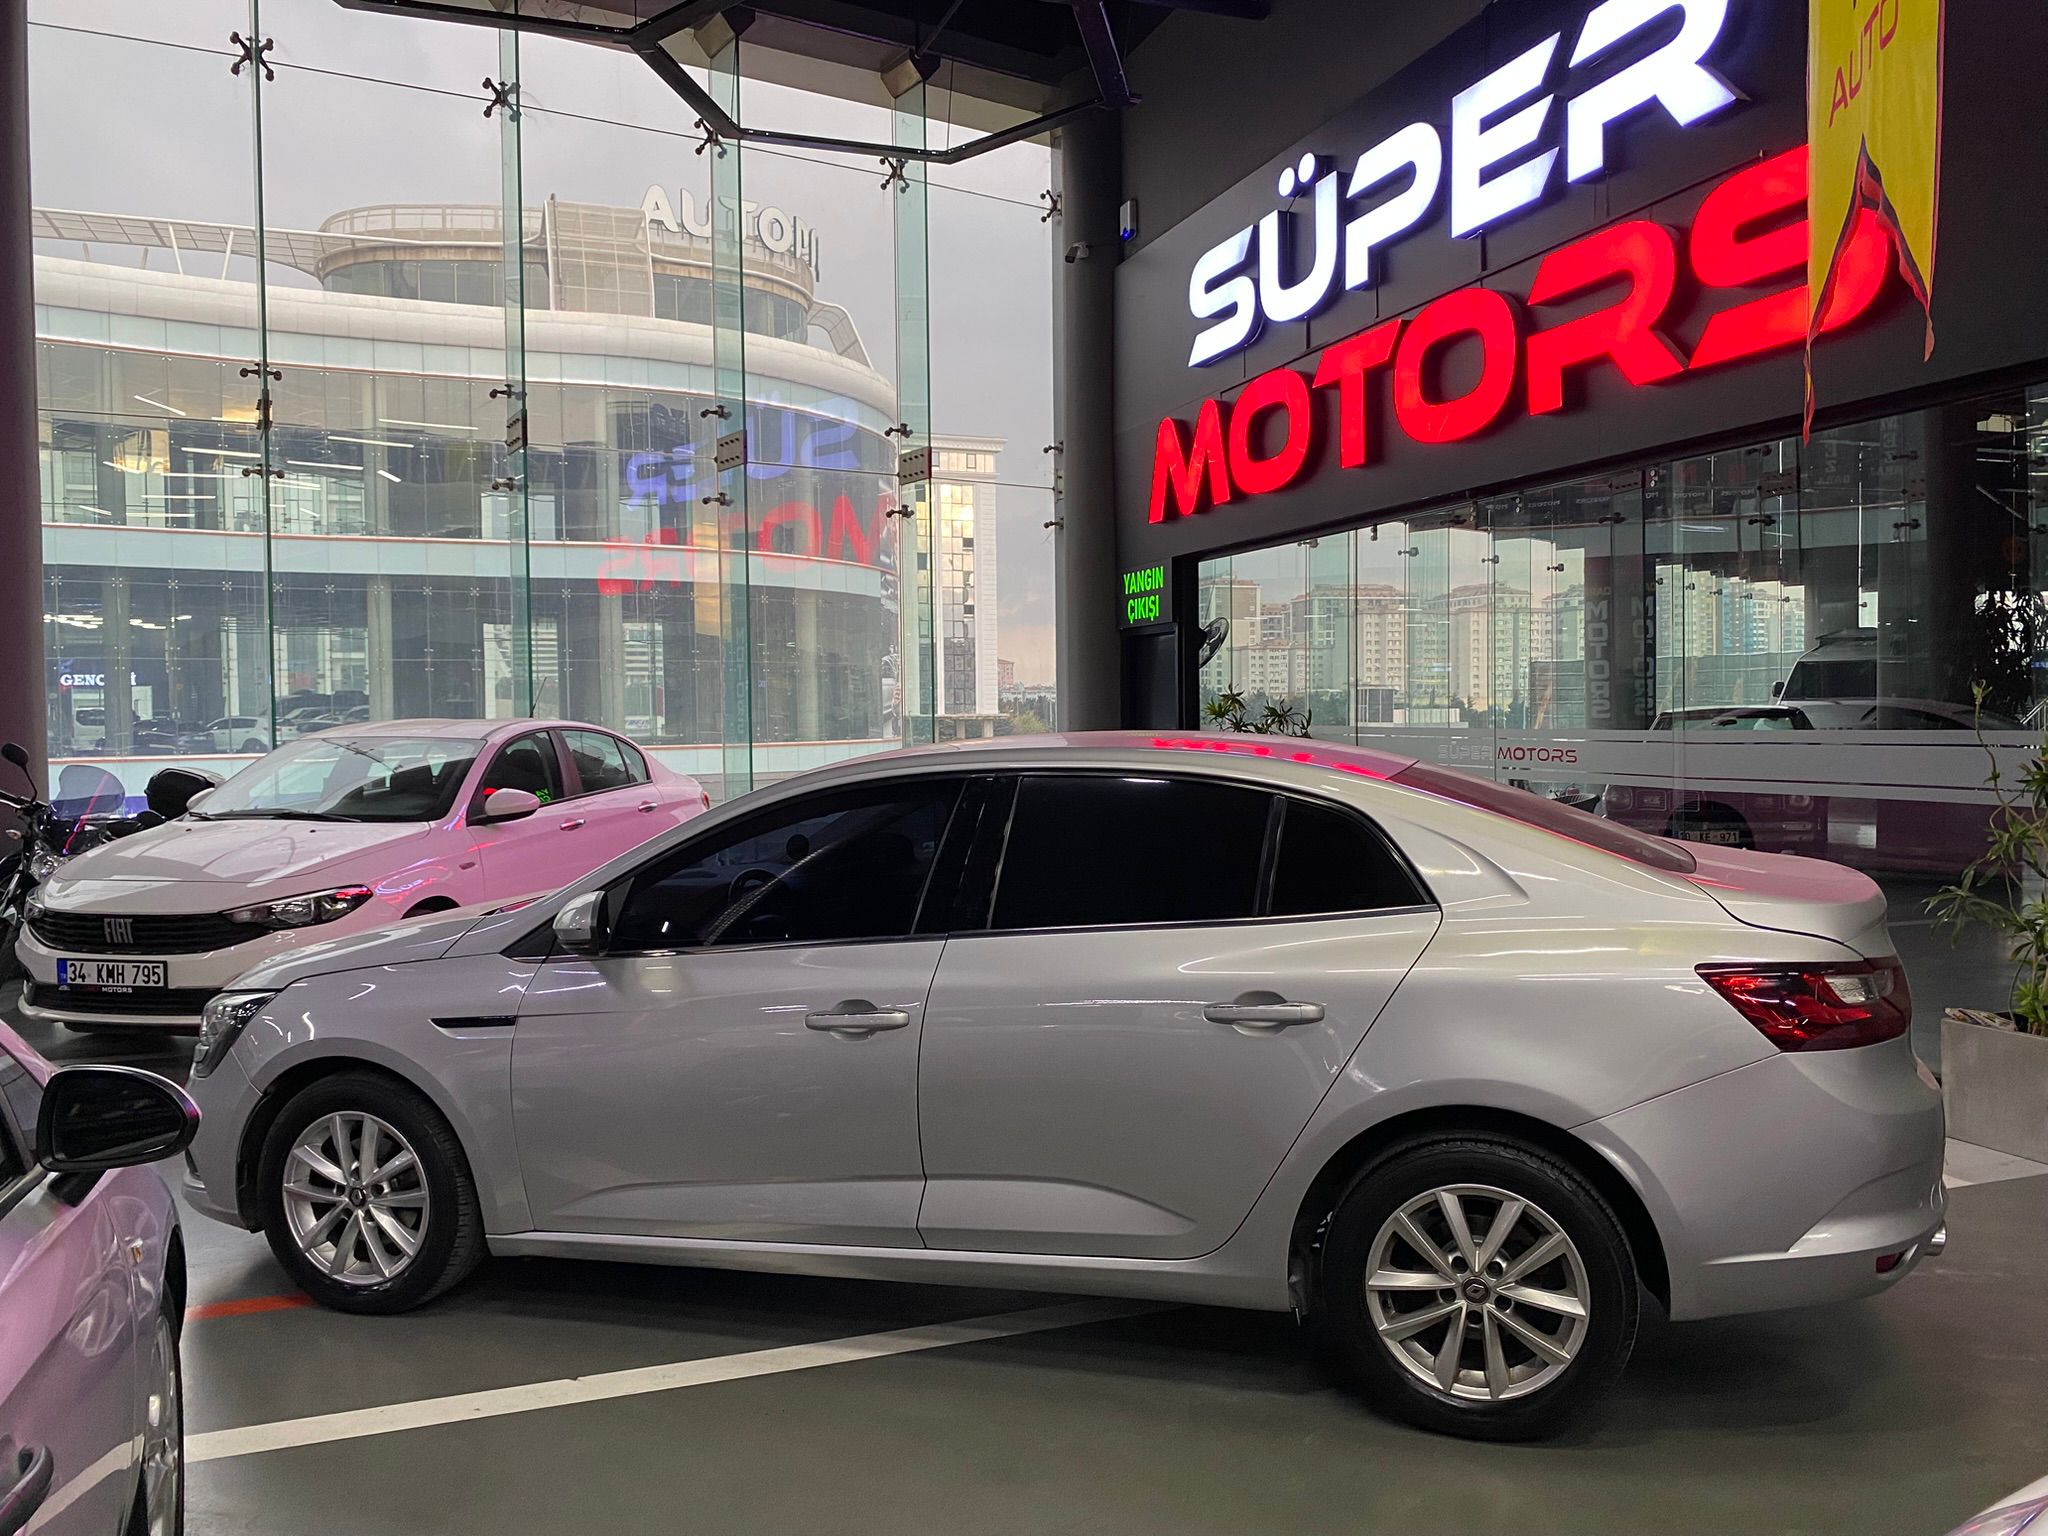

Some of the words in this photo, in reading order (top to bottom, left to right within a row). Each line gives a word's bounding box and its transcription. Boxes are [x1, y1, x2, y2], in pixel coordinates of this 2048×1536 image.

[1829, 0, 1899, 128] AUTO
[1188, 0, 1737, 367] SÜPER
[1148, 145, 1895, 524] MOTORS
[1123, 565, 1164, 595] YANGIN
[1127, 594, 1159, 624] ÇIKIŞI
[1497, 746, 1578, 763] MOTORS
[1719, 832, 1738, 842] 971
[104, 918, 134, 944] FIAT
[69, 962, 86, 982] 34
[97, 963, 125, 984] KMH
[132, 965, 161, 984] 795
